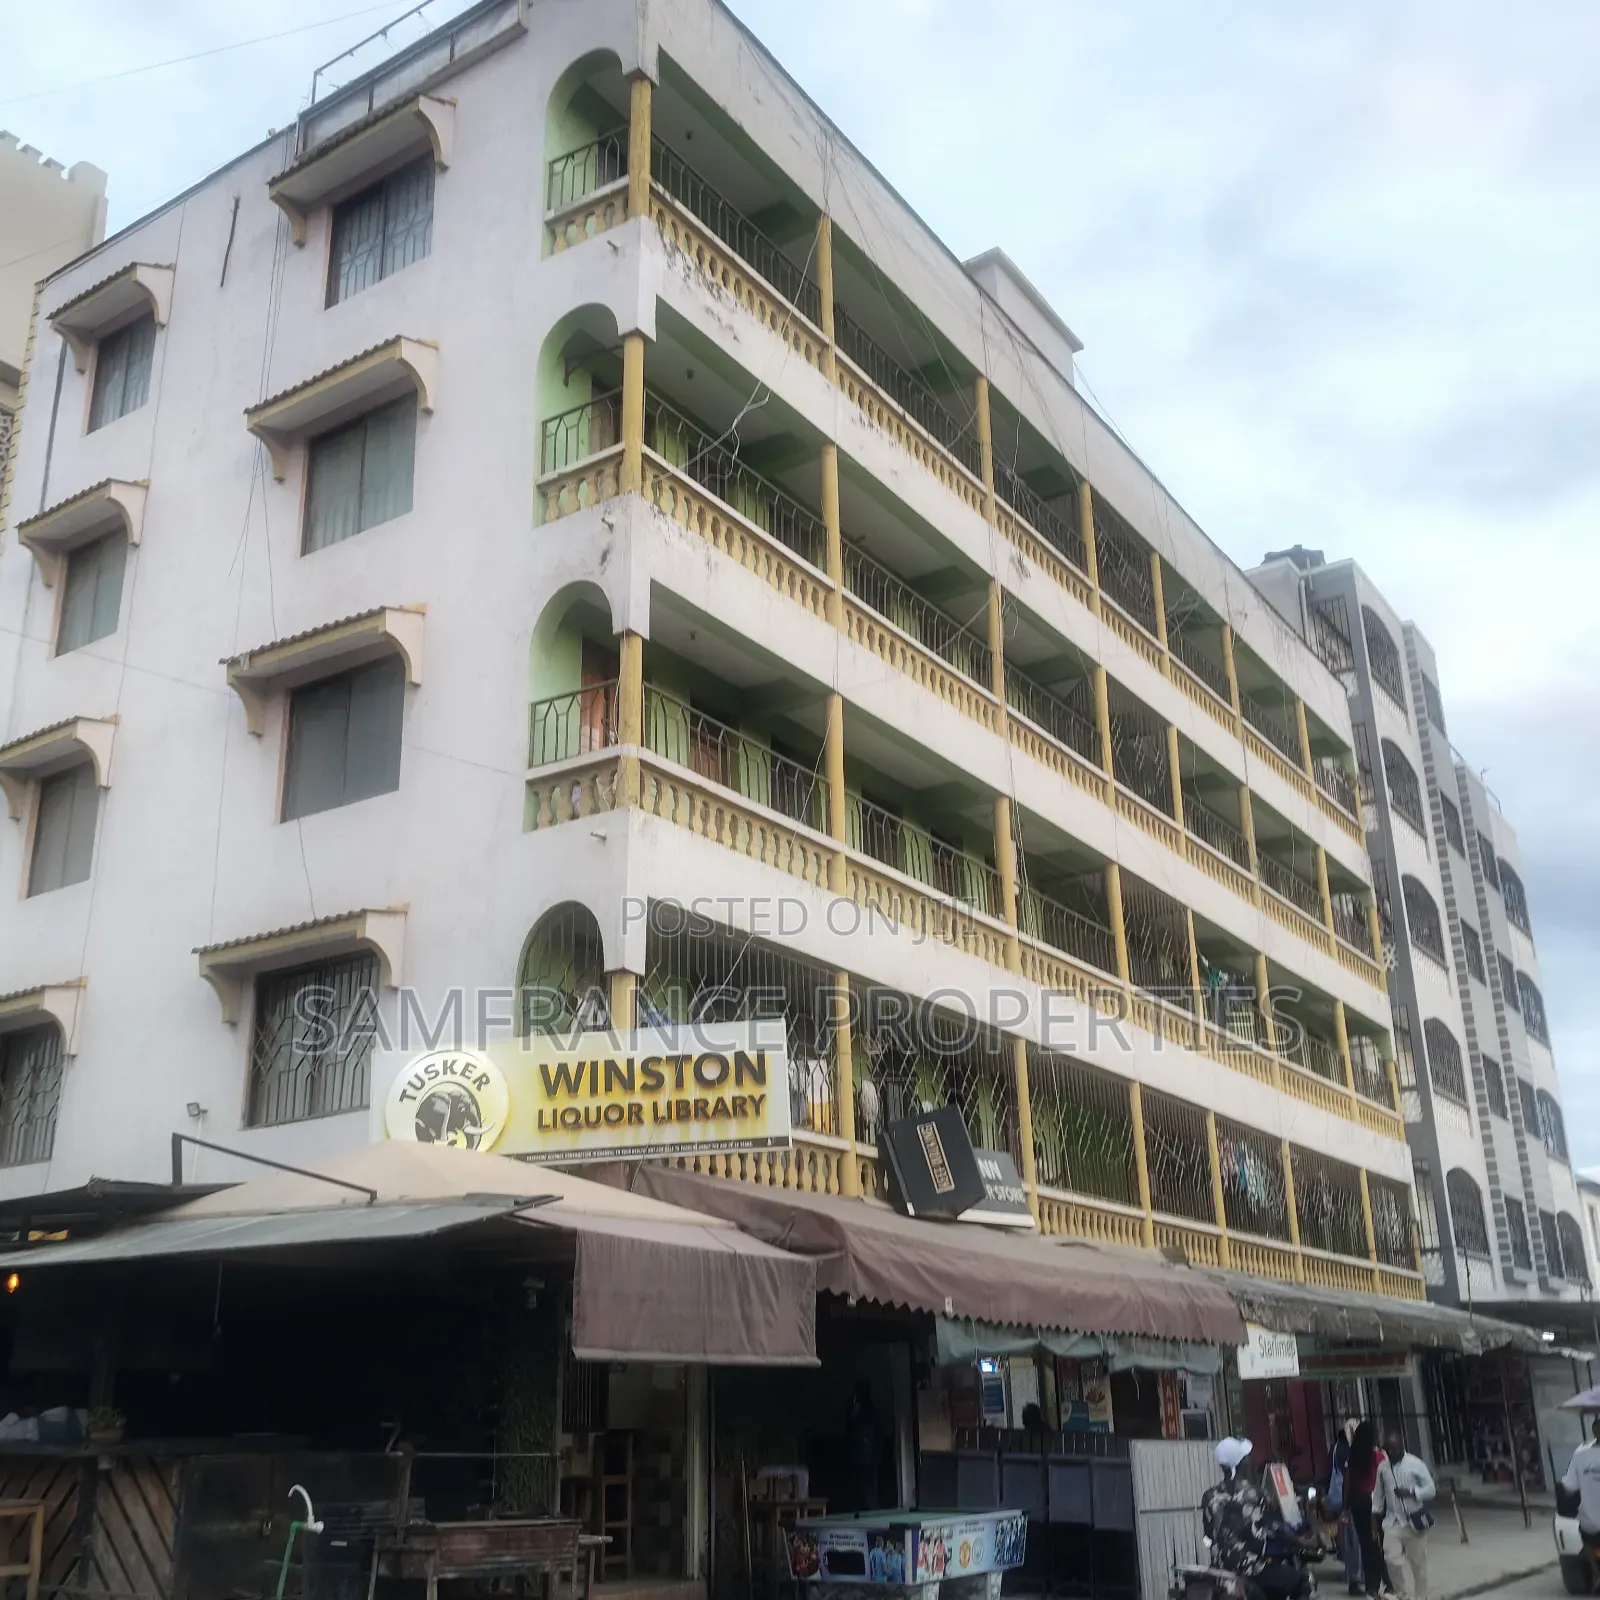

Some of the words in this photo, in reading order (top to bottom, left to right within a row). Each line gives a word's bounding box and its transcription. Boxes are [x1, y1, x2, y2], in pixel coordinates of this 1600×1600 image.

[398, 1059, 491, 1103] TUSKER
[539, 1049, 768, 1099] WINSTON
[537, 1102, 645, 1132] LIQUOR
[652, 1094, 767, 1124] LIBRARY
[976, 1157, 1003, 1181] NN
